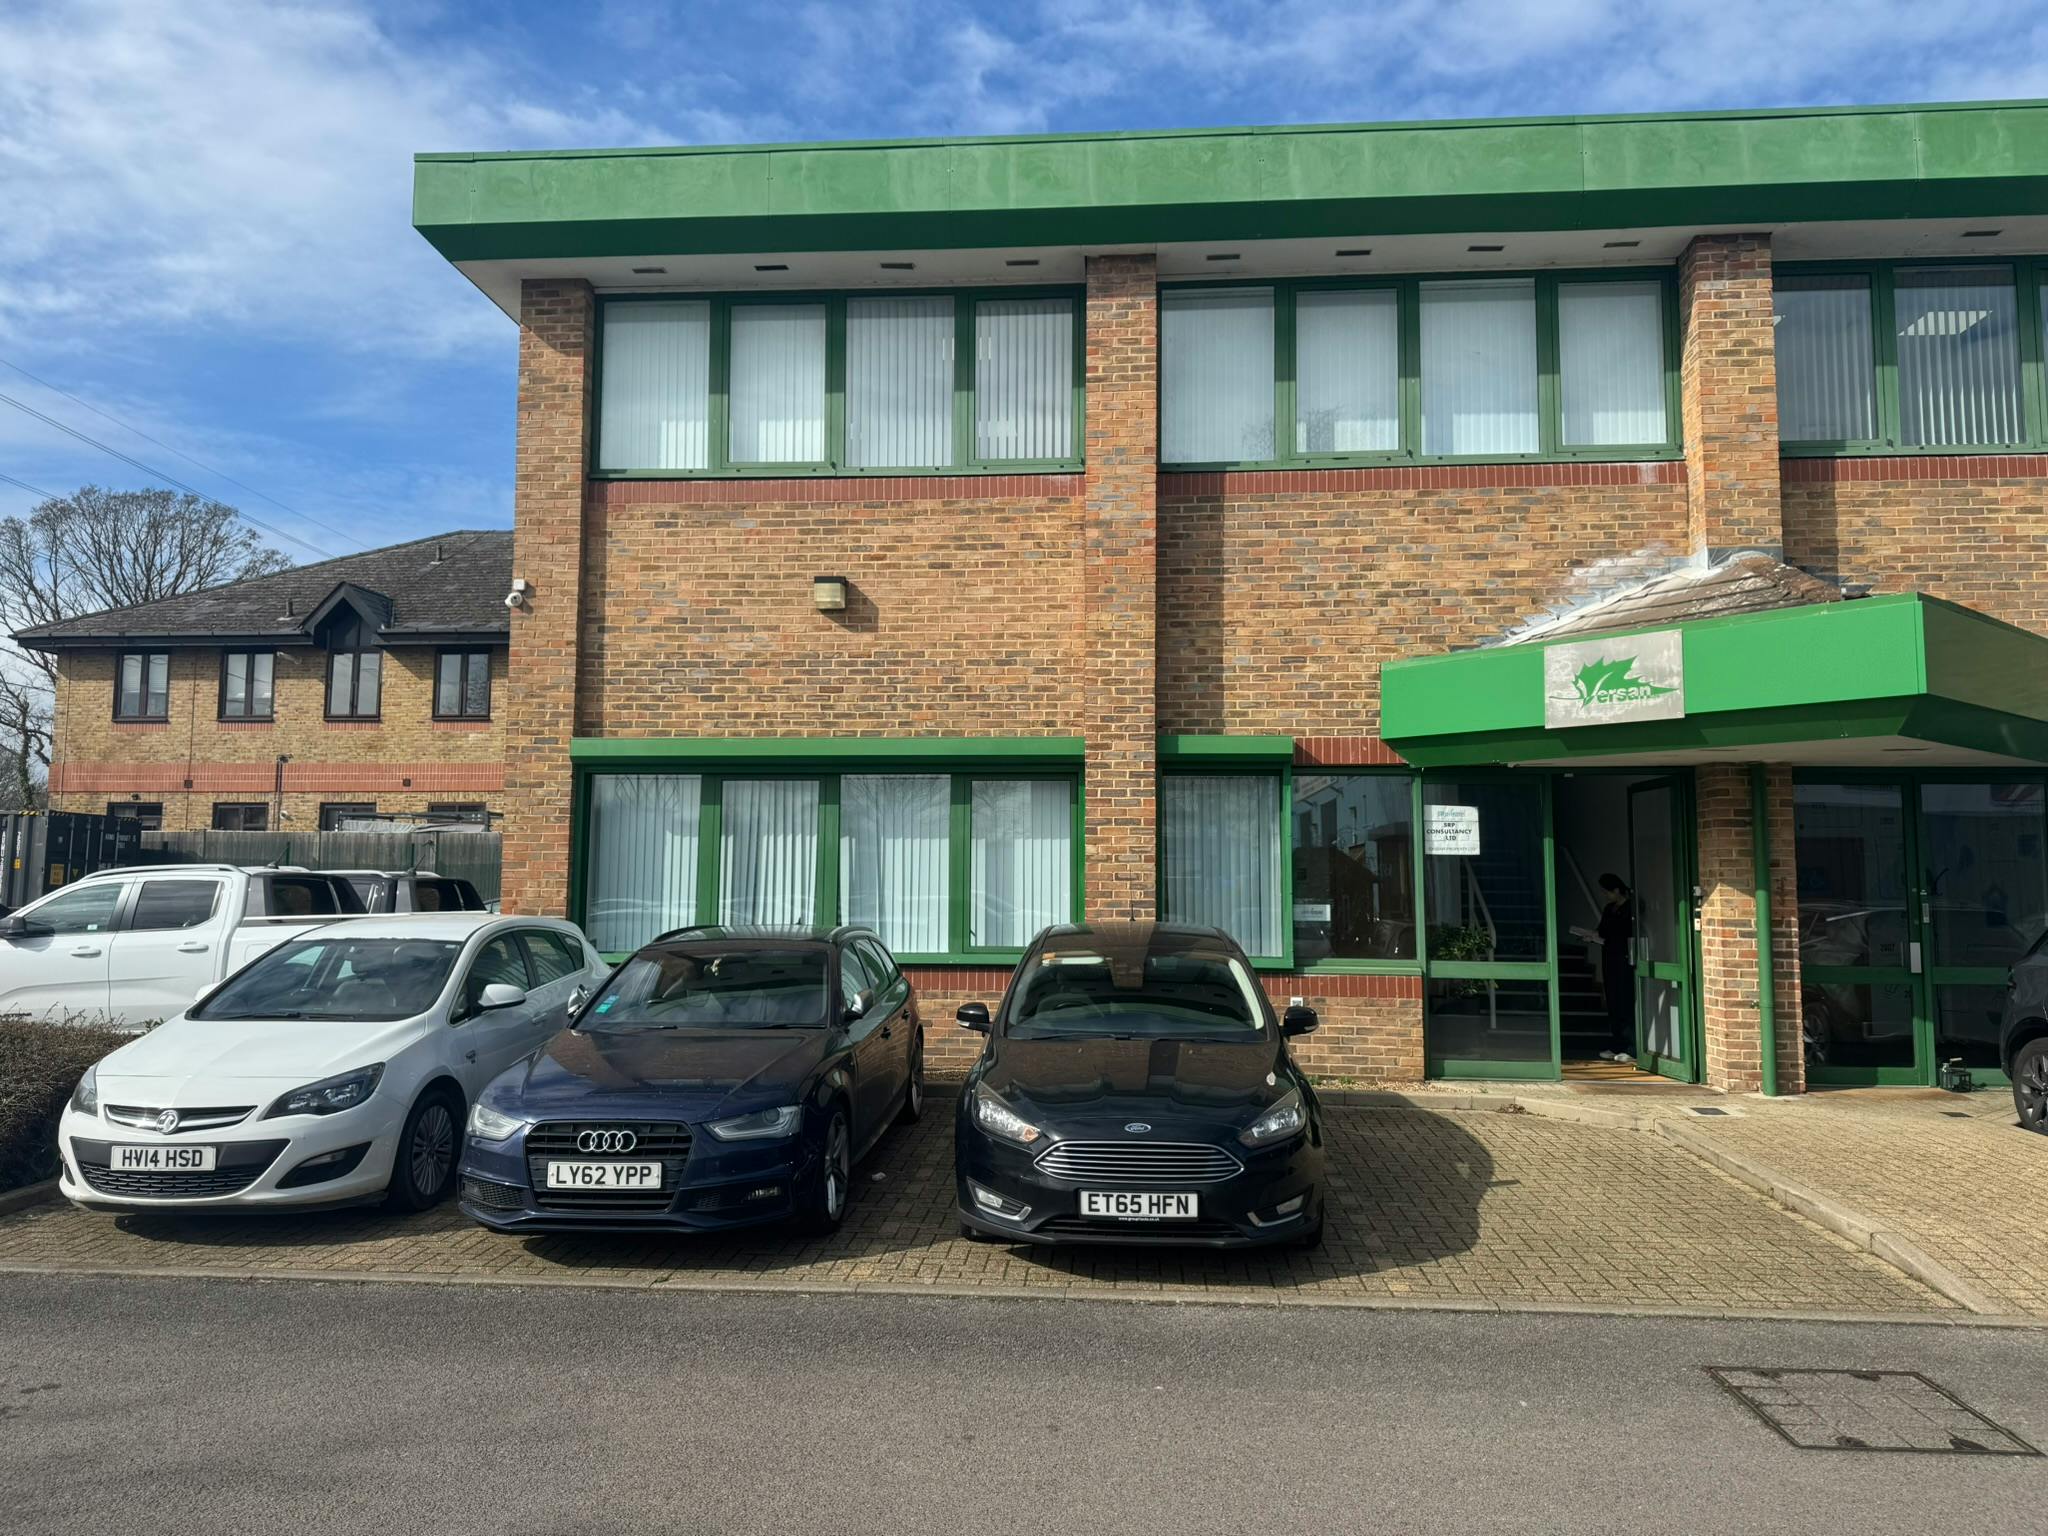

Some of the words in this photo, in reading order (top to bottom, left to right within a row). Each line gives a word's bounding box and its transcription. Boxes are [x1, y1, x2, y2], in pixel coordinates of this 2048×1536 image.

[1577, 672, 1651, 706] Versan
[121, 1149, 160, 1168] HV14
[165, 1149, 203, 1168] HSD
[555, 1165, 607, 1185] LY62
[613, 1166, 652, 1185] YPP
[1087, 1193, 1142, 1214] ET65
[1148, 1194, 1189, 1215] HFN
